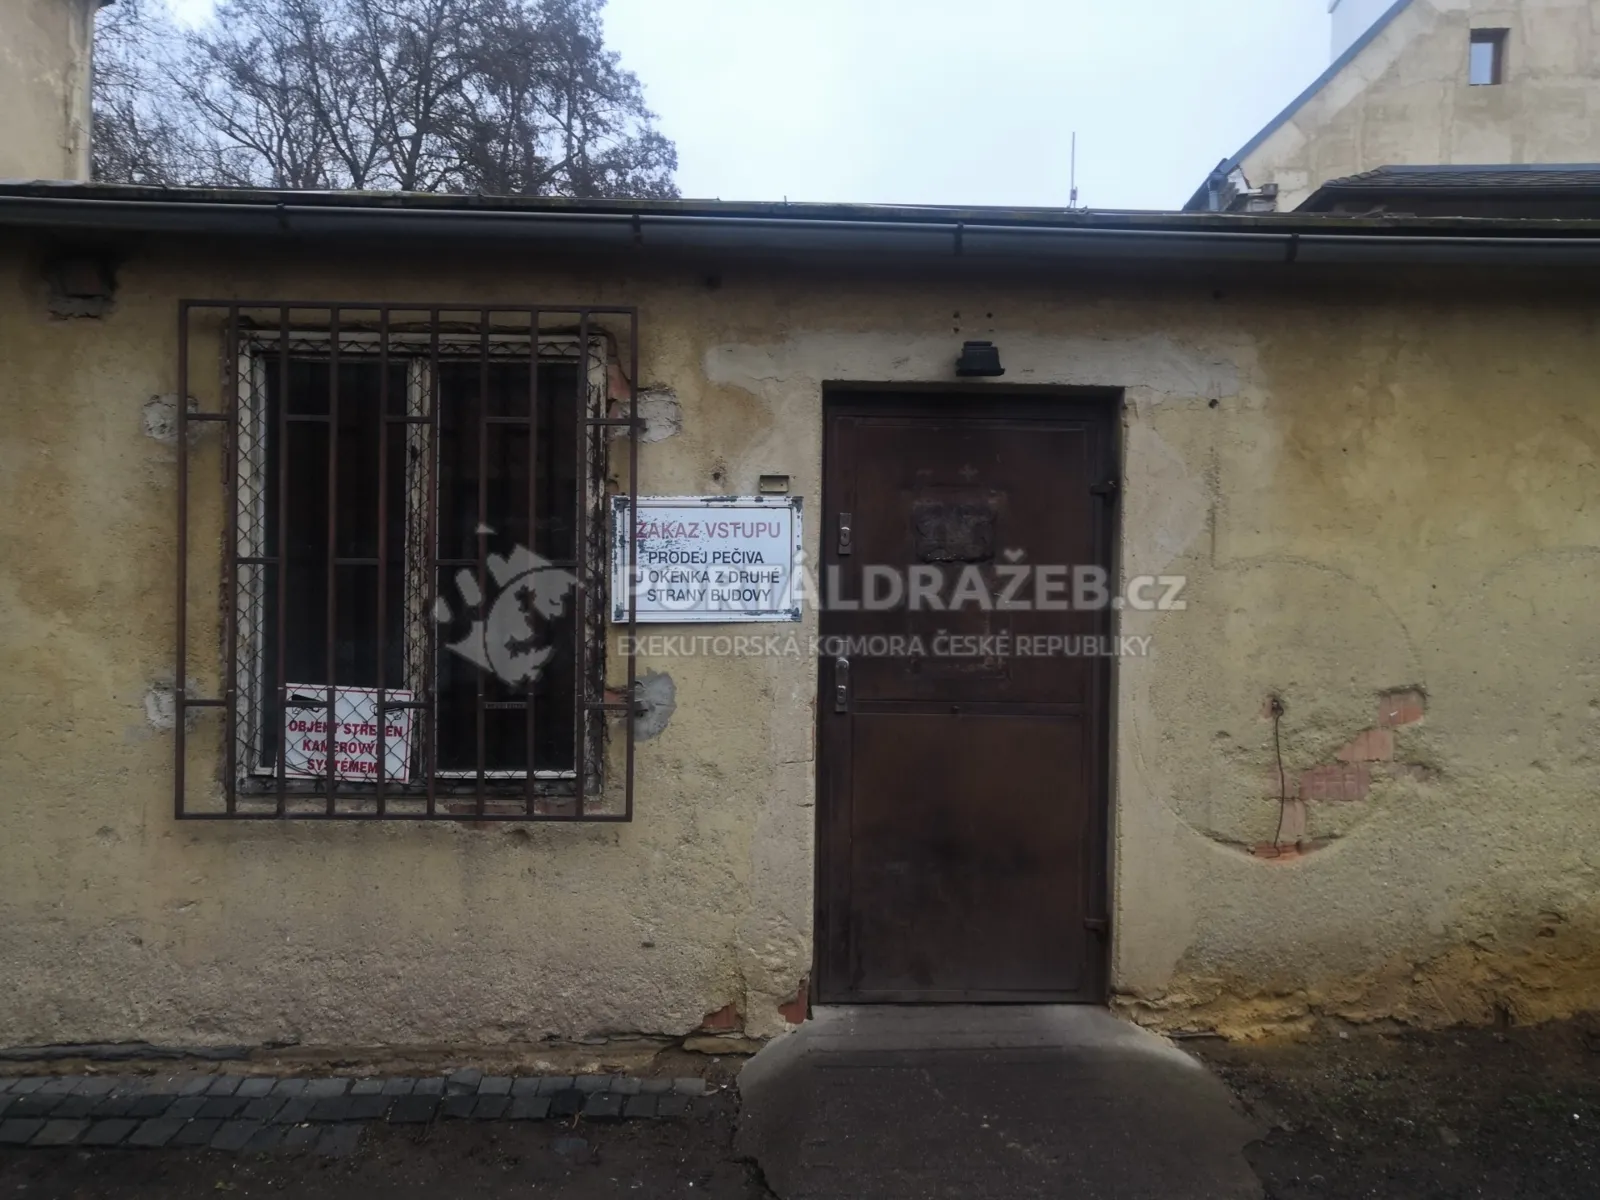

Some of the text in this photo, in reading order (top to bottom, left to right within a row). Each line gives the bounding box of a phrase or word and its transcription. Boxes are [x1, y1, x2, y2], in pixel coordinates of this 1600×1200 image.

[704, 522, 781, 538] VSTUPU
[648, 548, 764, 564] PRODEJ PEČIVA
[648, 567, 710, 583] OKÉNKA
[714, 570, 724, 583] Z
[728, 568, 780, 583] DRUHÉ
[647, 588, 772, 602] STRANY BUDOVY
[343, 721, 403, 737] STŘEEN
[303, 739, 379, 755] KAMEROVÝ
